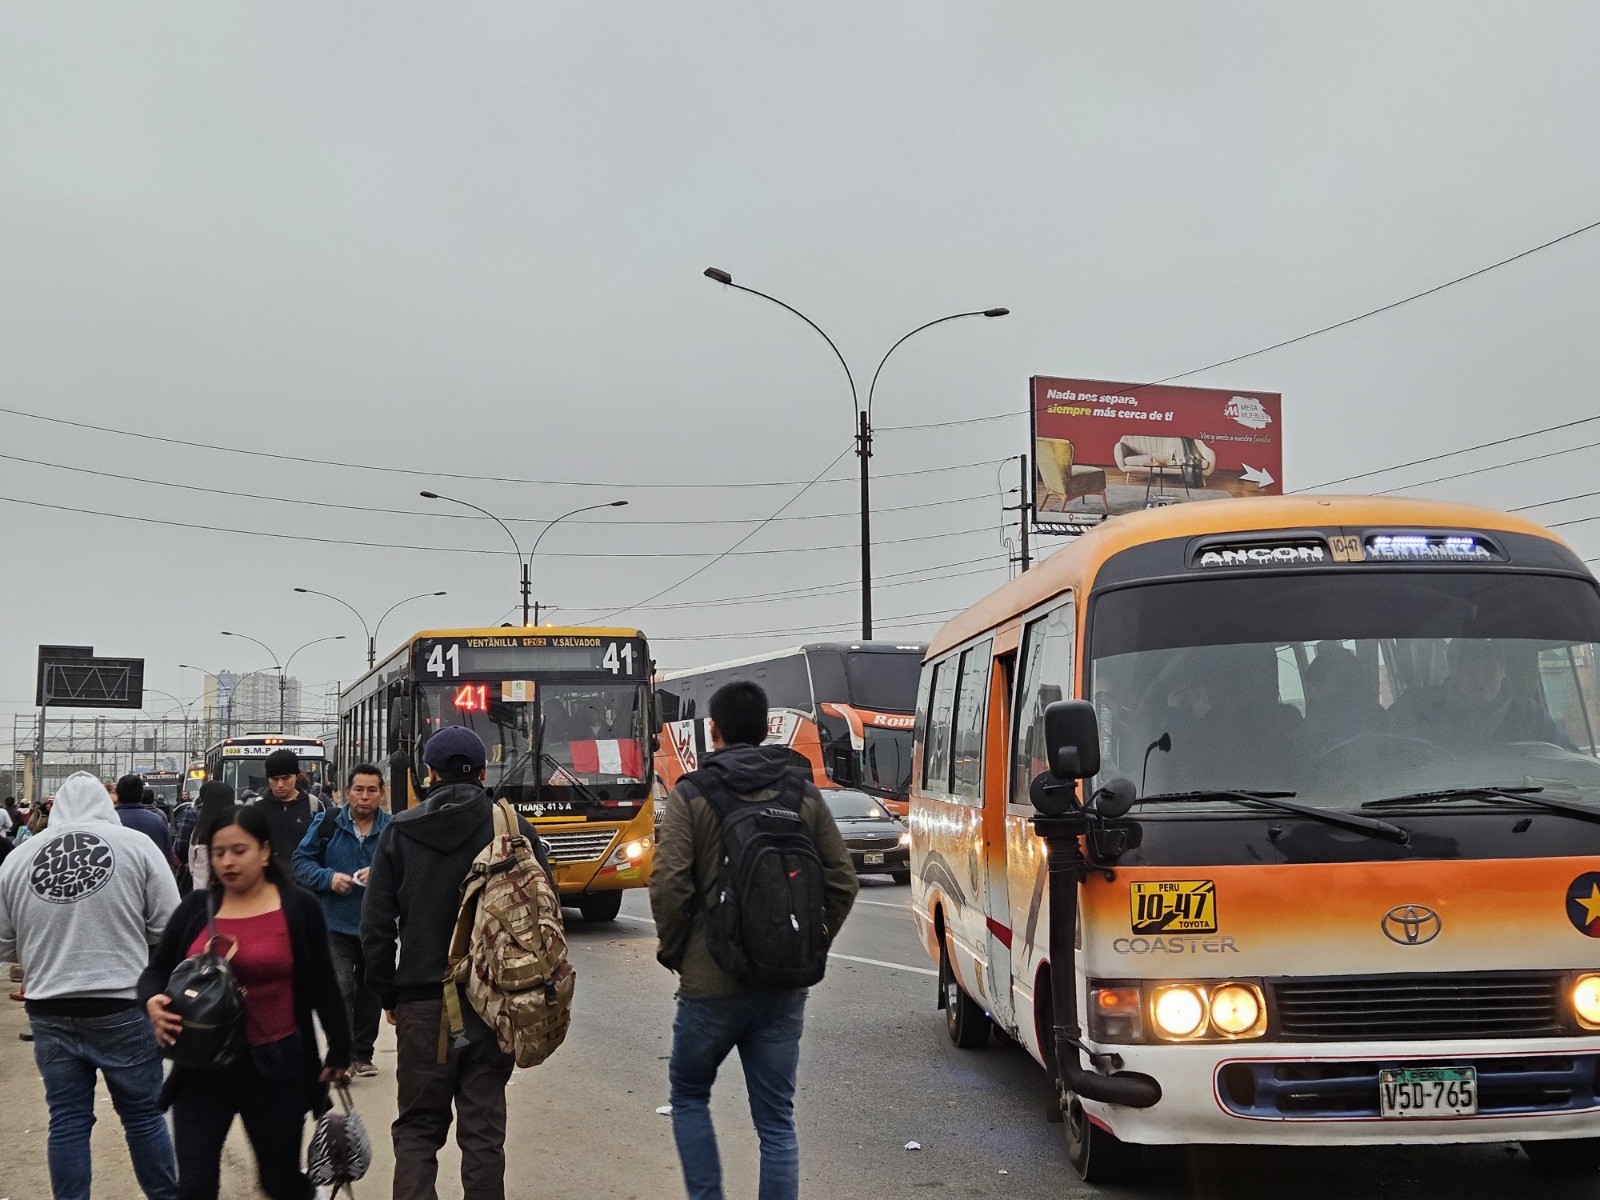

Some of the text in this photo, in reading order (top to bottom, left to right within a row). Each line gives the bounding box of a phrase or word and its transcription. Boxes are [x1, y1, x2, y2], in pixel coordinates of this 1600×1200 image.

[1047, 389, 1138, 407] Nada nos separa,
[1047, 403, 1174, 421] siempre más cerca de ti
[1241, 412, 1269, 420] MUEBLES
[1200, 547, 1324, 566] ANCON
[467, 638, 518, 647] VENTANILLA
[552, 638, 601, 647] V.SALVADOR
[427, 644, 460, 677] 41
[603, 642, 633, 674] 41
[455, 685, 488, 710] 41
[547, 802, 557, 810] 41
[33, 833, 100, 866] RIP
[31, 846, 112, 885] CURL
[1159, 884, 1180, 892] PERU
[1137, 893, 1207, 920] 10-47
[1179, 920, 1210, 928] TOYOTA
[1113, 936, 1240, 954] COASTER
[1385, 1081, 1473, 1111] V5D-765
